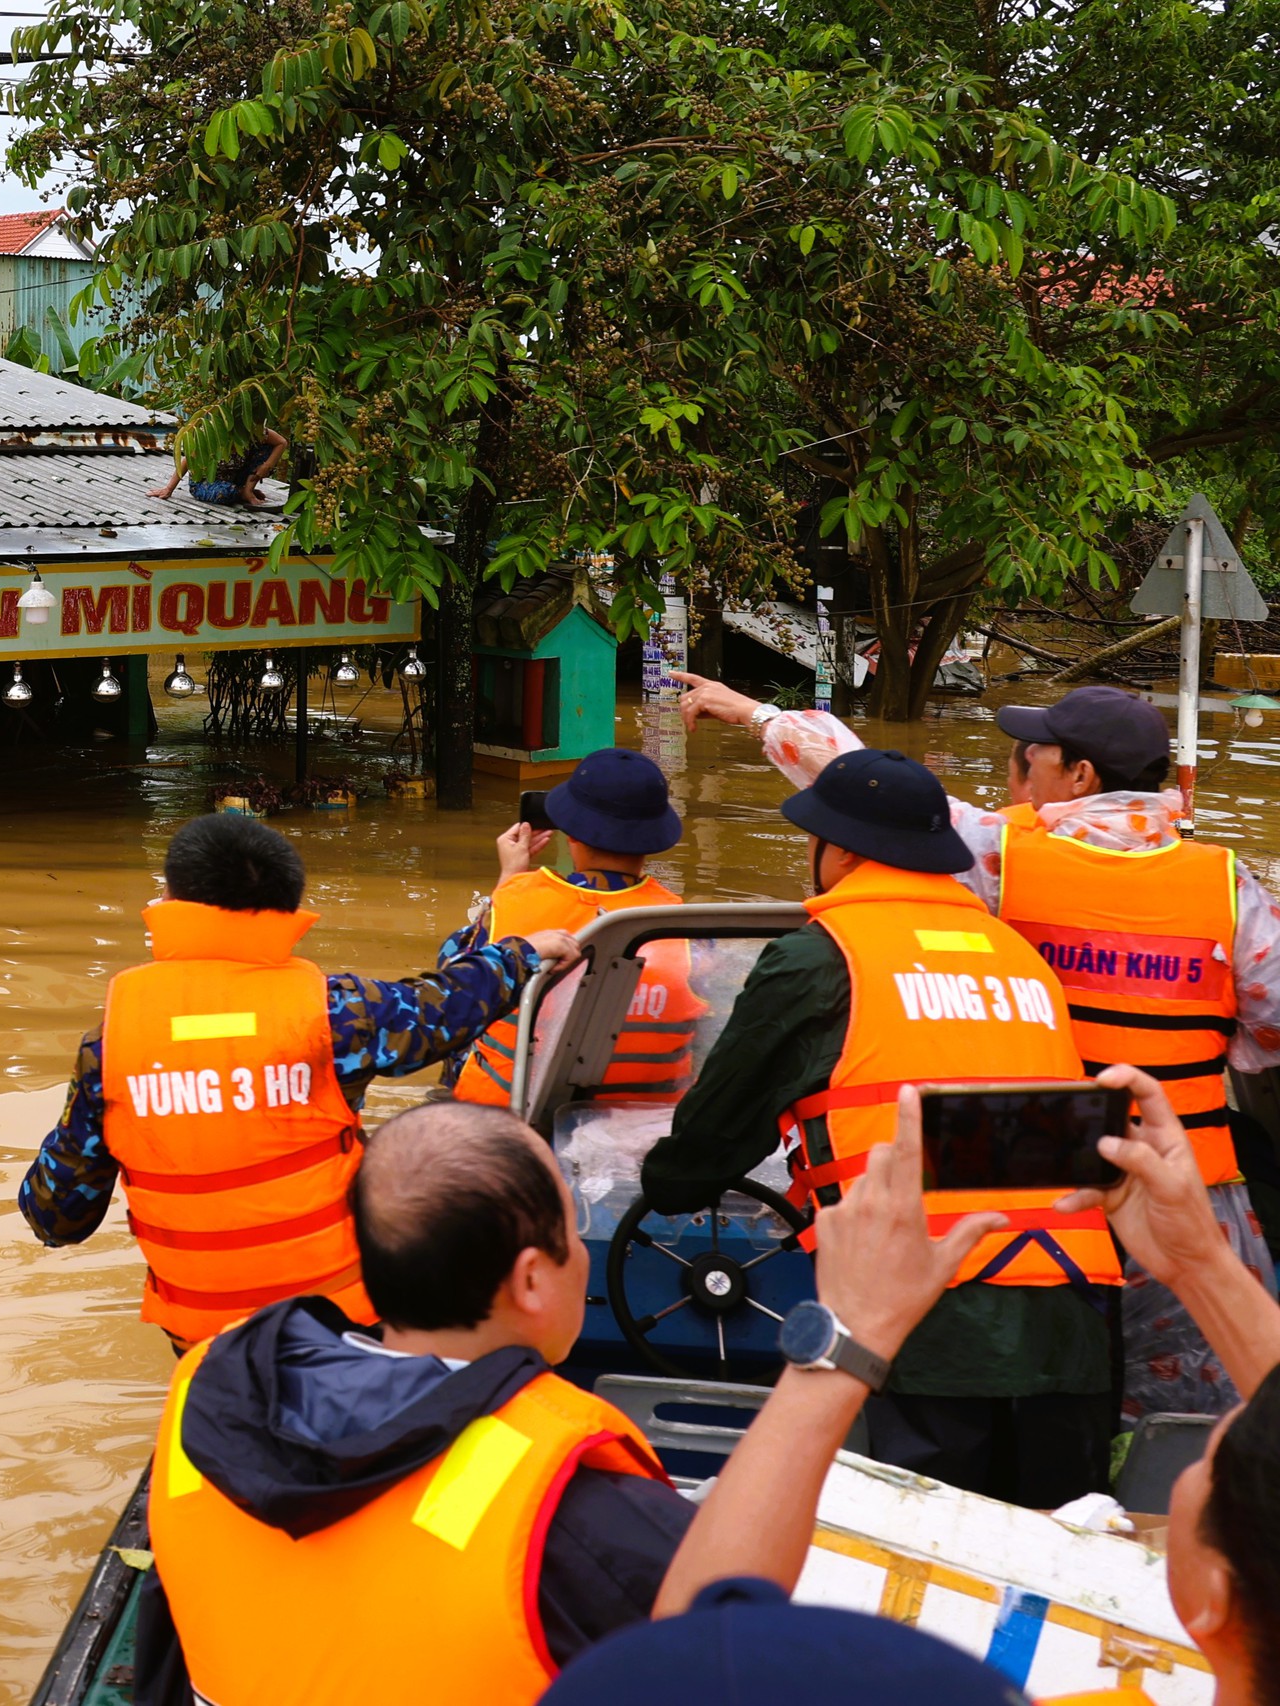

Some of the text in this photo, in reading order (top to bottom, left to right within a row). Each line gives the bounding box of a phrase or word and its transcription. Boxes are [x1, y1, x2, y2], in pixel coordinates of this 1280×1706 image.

[1125, 951, 1180, 981] KHU
[1187, 957, 1203, 983] 5
[626, 983, 668, 1019] HQ
[892, 962, 1057, 1030] VÙNG 3 HQ
[230, 1066, 256, 1111] 3
[263, 1062, 312, 1108] HQ
